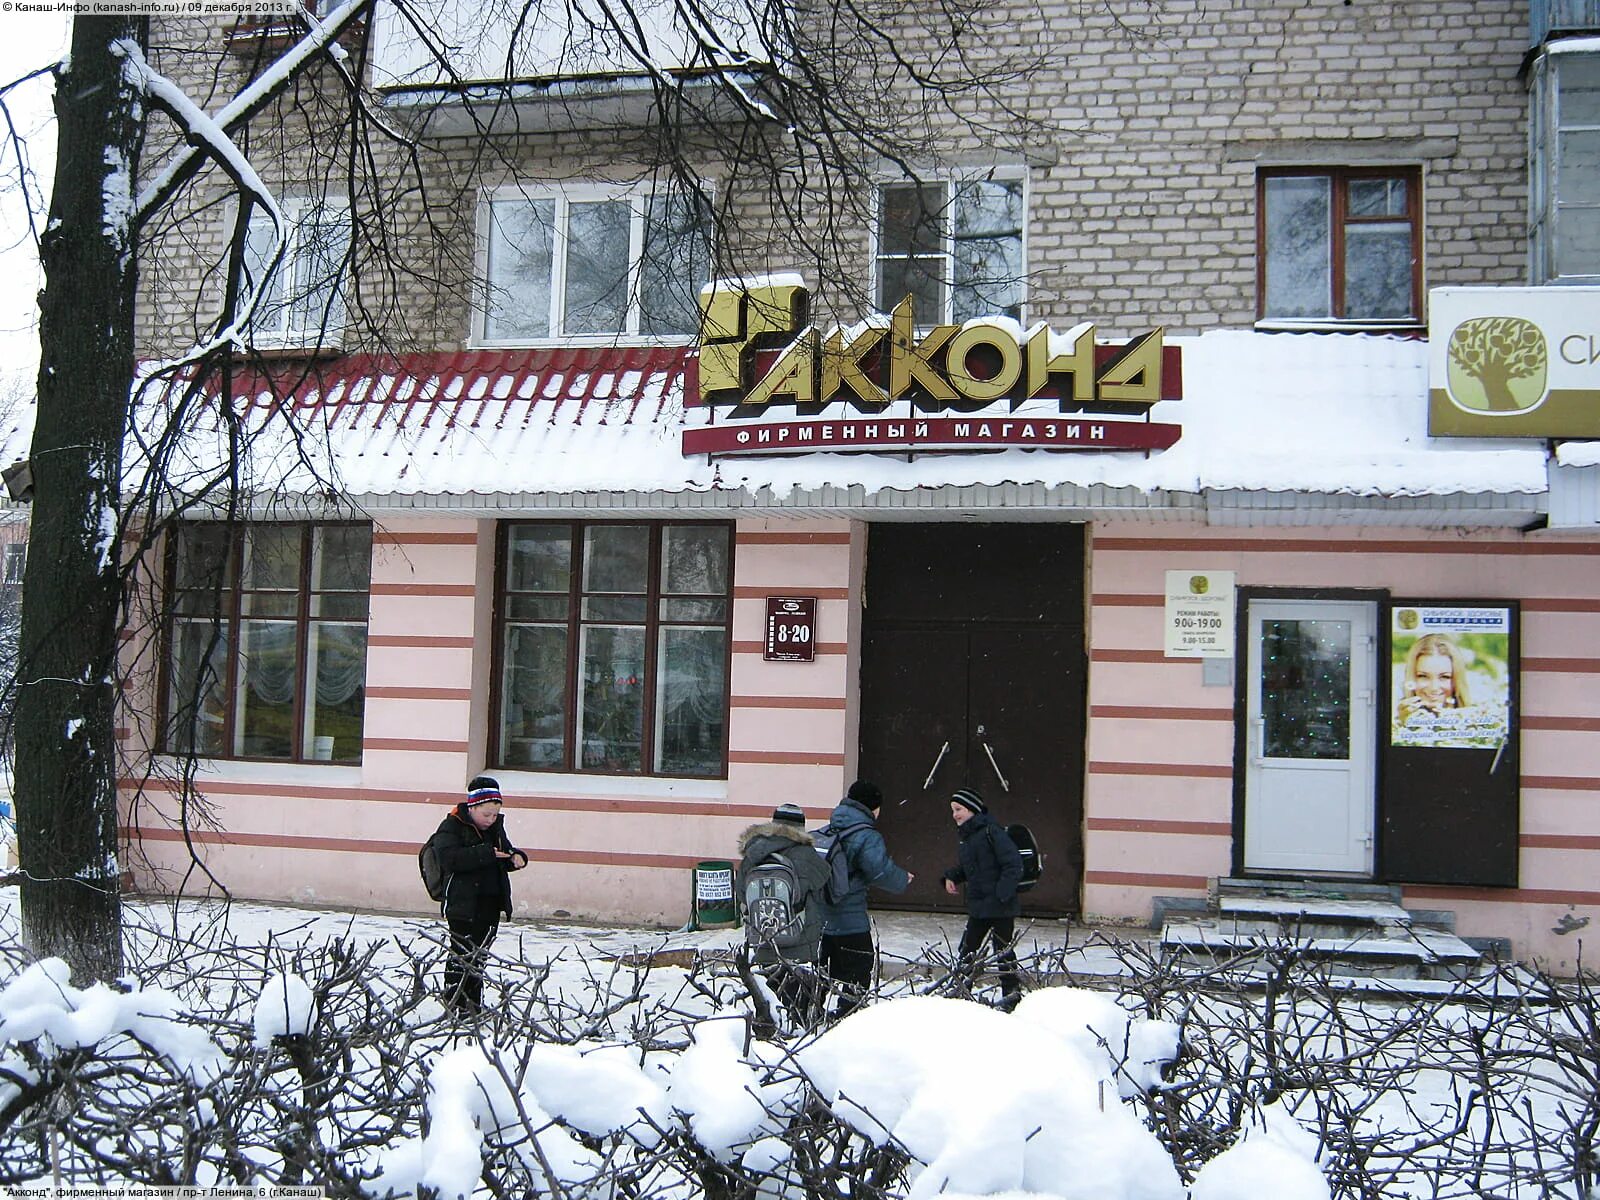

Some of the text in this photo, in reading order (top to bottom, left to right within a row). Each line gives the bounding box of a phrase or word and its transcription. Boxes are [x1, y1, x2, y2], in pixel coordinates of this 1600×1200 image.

[742, 292, 1163, 404] АККОНД
[736, 422, 1106, 443] ФИРМЕННЫЙ МАГАЗИН
[777, 624, 810, 643] 8-20
